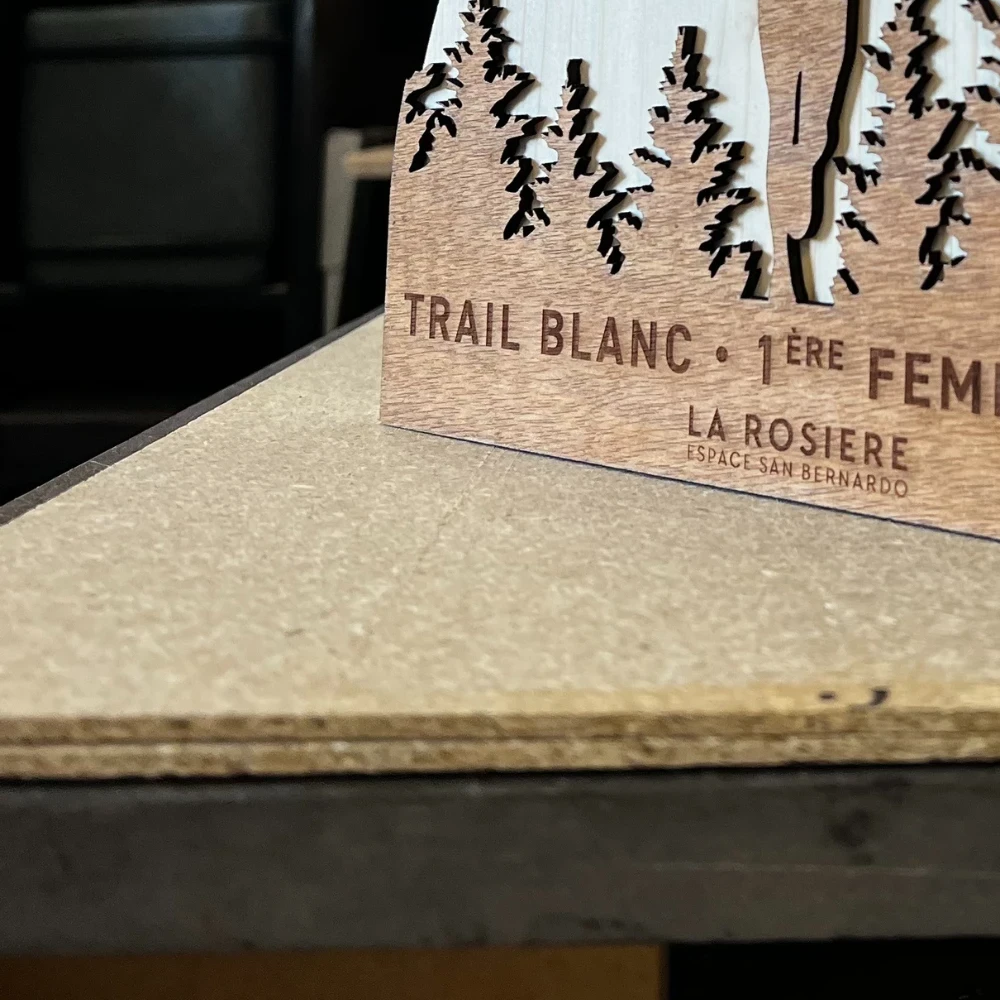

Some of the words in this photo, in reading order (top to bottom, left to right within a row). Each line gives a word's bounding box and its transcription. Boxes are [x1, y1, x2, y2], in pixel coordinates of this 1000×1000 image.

[404, 292, 520, 352] TRAIL
[540, 308, 692, 375] BLANC
[687, 443, 750, 471] ESPACE
[759, 456, 793, 478] SAN
[801, 462, 909, 499] BERNARDO
[688, 404, 726, 441] LA
[745, 413, 908, 472] ROSIERE
